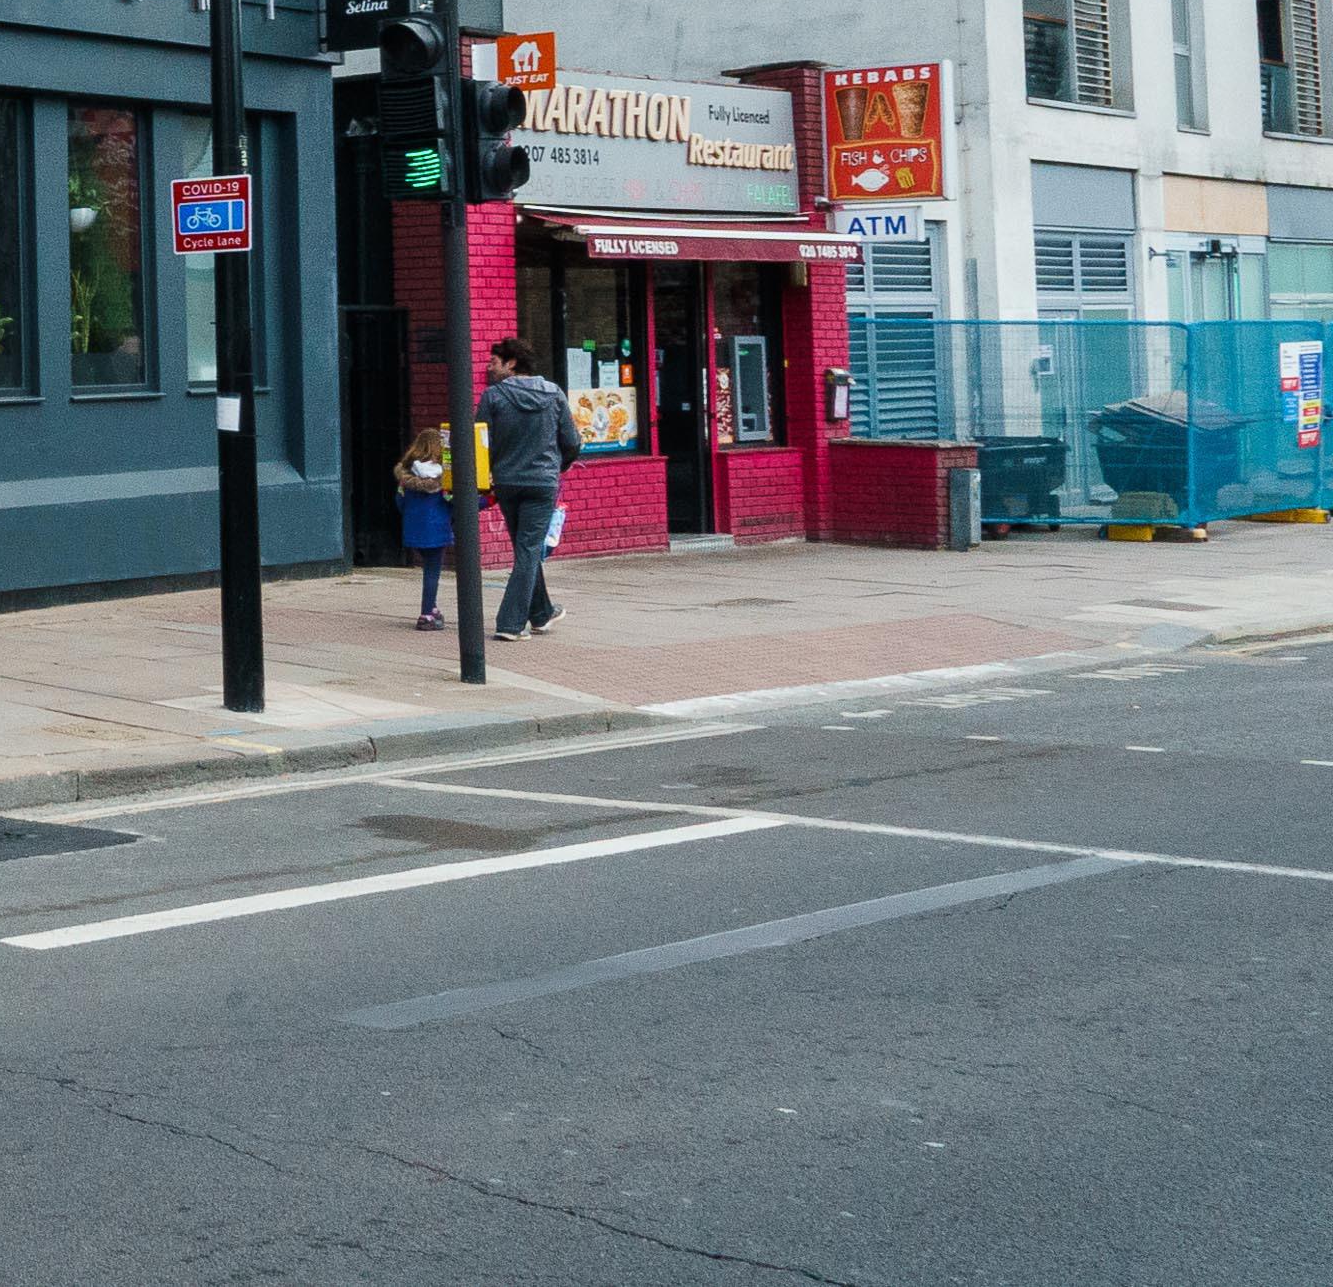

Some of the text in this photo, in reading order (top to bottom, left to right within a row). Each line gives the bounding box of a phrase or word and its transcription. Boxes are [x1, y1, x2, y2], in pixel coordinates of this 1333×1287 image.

[504, 73, 550, 86] JUST EAT
[834, 66, 931, 86] KEBABS
[519, 84, 691, 142] MARATHON
[708, 105, 770, 125] Fully Licenced
[550, 147, 571, 163] 485
[573, 148, 599, 165] 3814
[690, 133, 794, 171] Restaurant
[840, 147, 927, 166] FISH & CHIPS
[182, 181, 239, 196] COVID-19
[848, 215, 907, 236] ATM
[183, 236, 241, 249] Cycle lane
[594, 239, 678, 255] FULLY LICENSED
